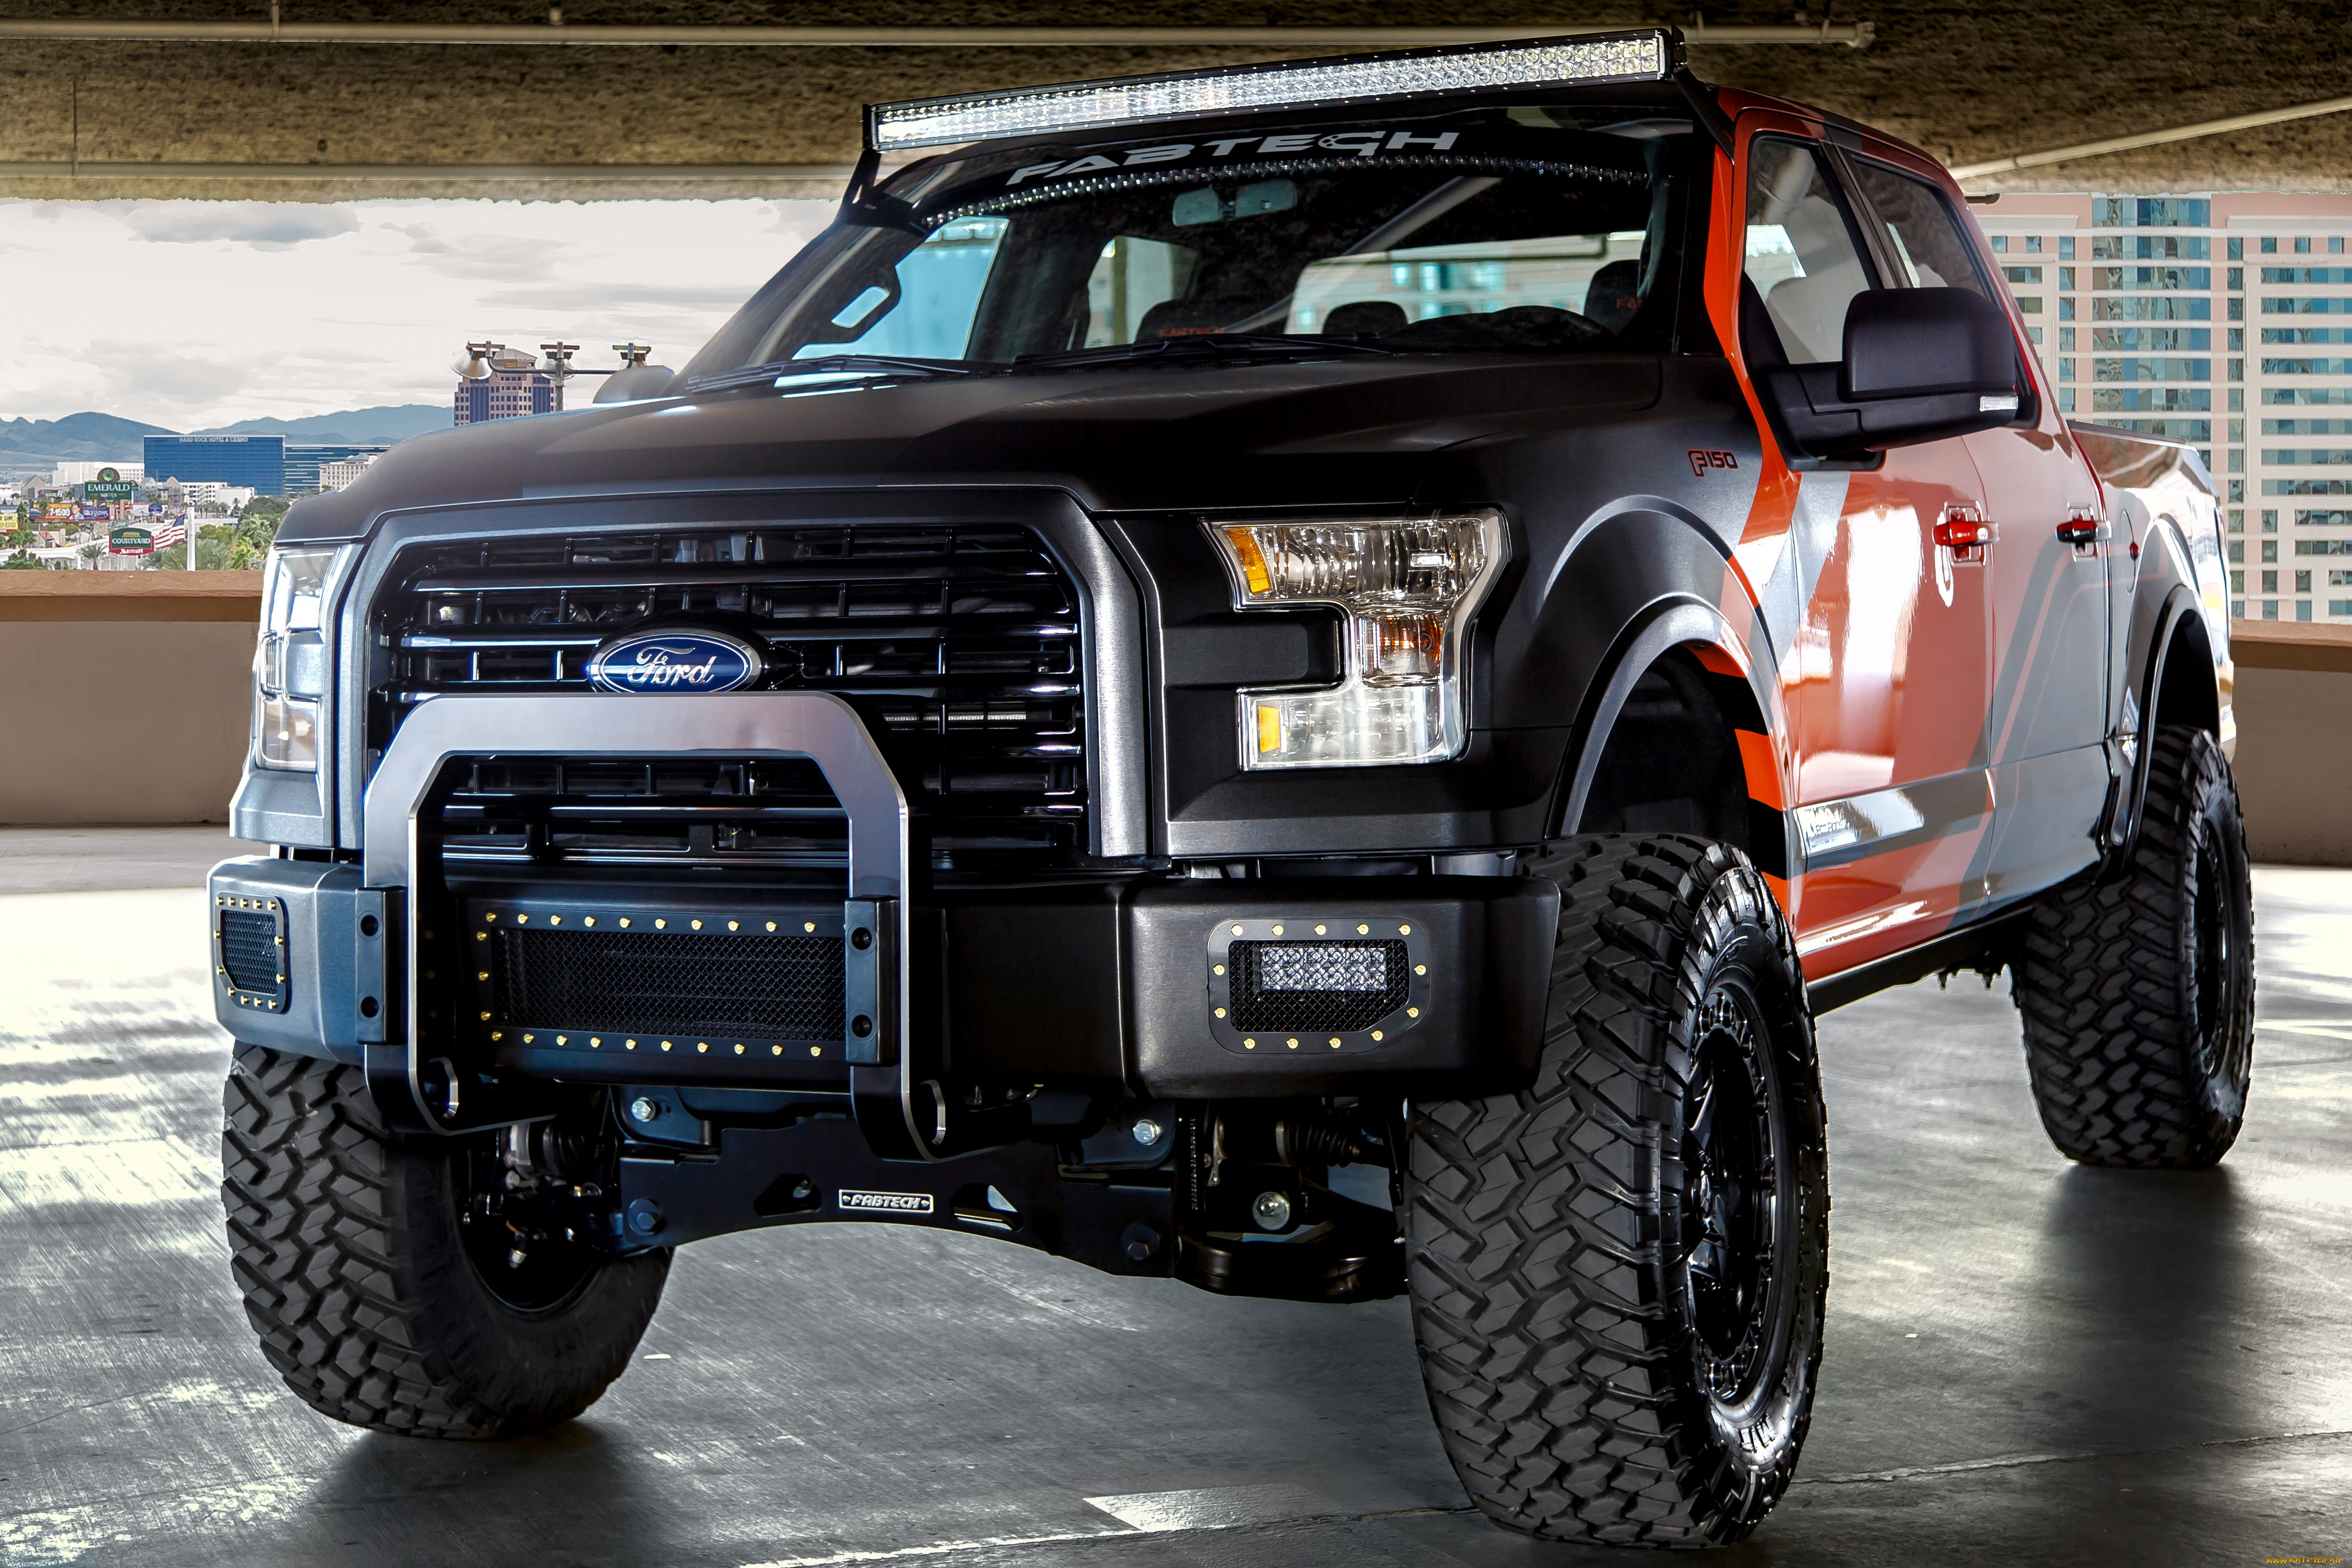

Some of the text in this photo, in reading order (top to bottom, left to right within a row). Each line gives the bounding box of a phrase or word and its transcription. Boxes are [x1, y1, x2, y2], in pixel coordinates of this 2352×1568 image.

[1005, 131, 1460, 186] FABTECH
[627, 646, 717, 687] Ford
[851, 1194, 921, 1209] FABTECH
